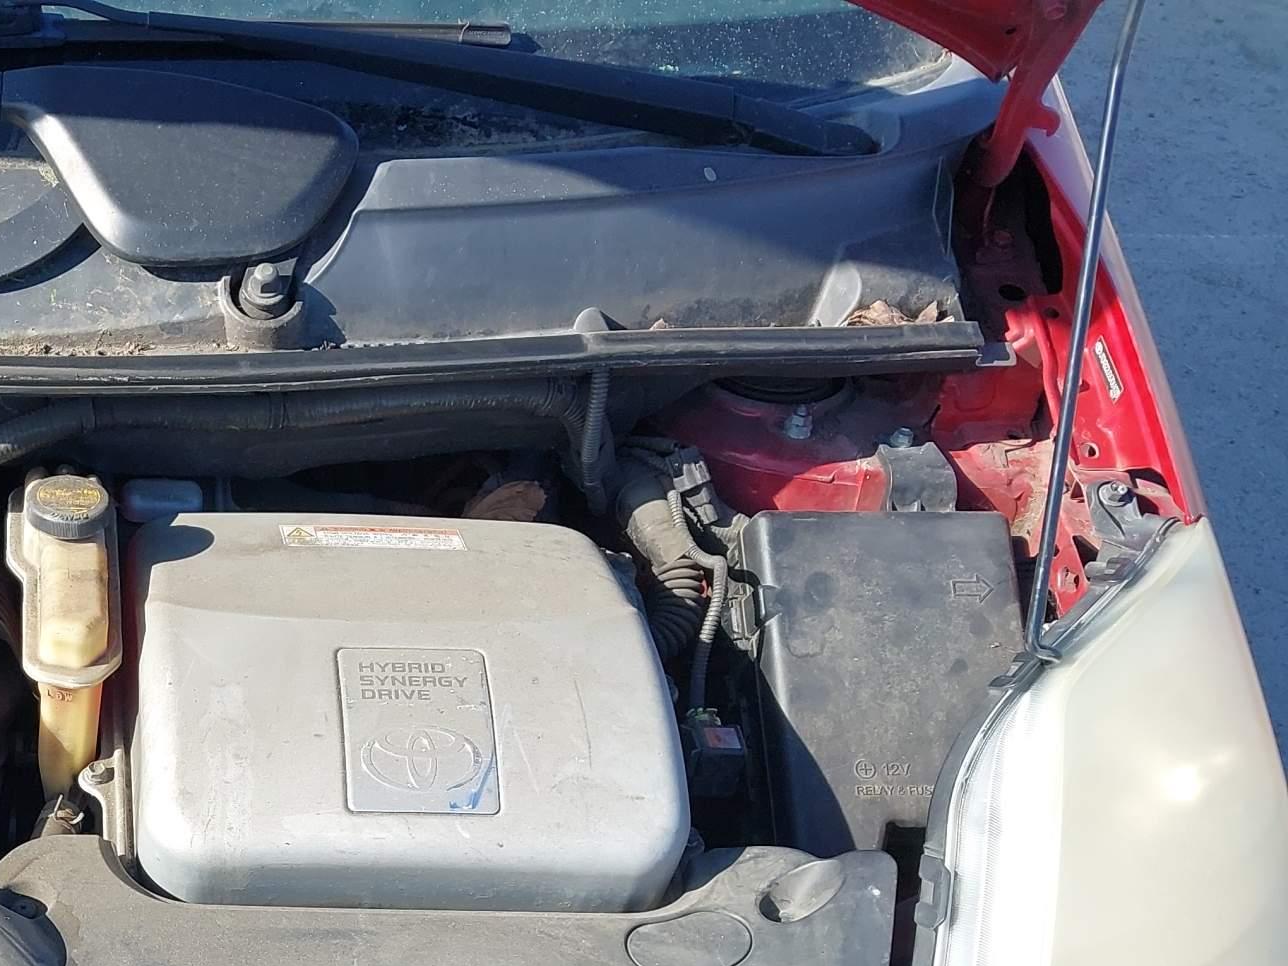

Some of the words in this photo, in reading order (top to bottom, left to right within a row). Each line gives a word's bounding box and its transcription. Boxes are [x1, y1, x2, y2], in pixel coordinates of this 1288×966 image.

[358, 662, 446, 673] HYBRID
[359, 675, 468, 688] SYNERGY
[361, 688, 431, 701] DRIVE
[882, 763, 912, 777] 12V
[856, 785, 894, 797] RELAY
[909, 785, 934, 798] FUS
